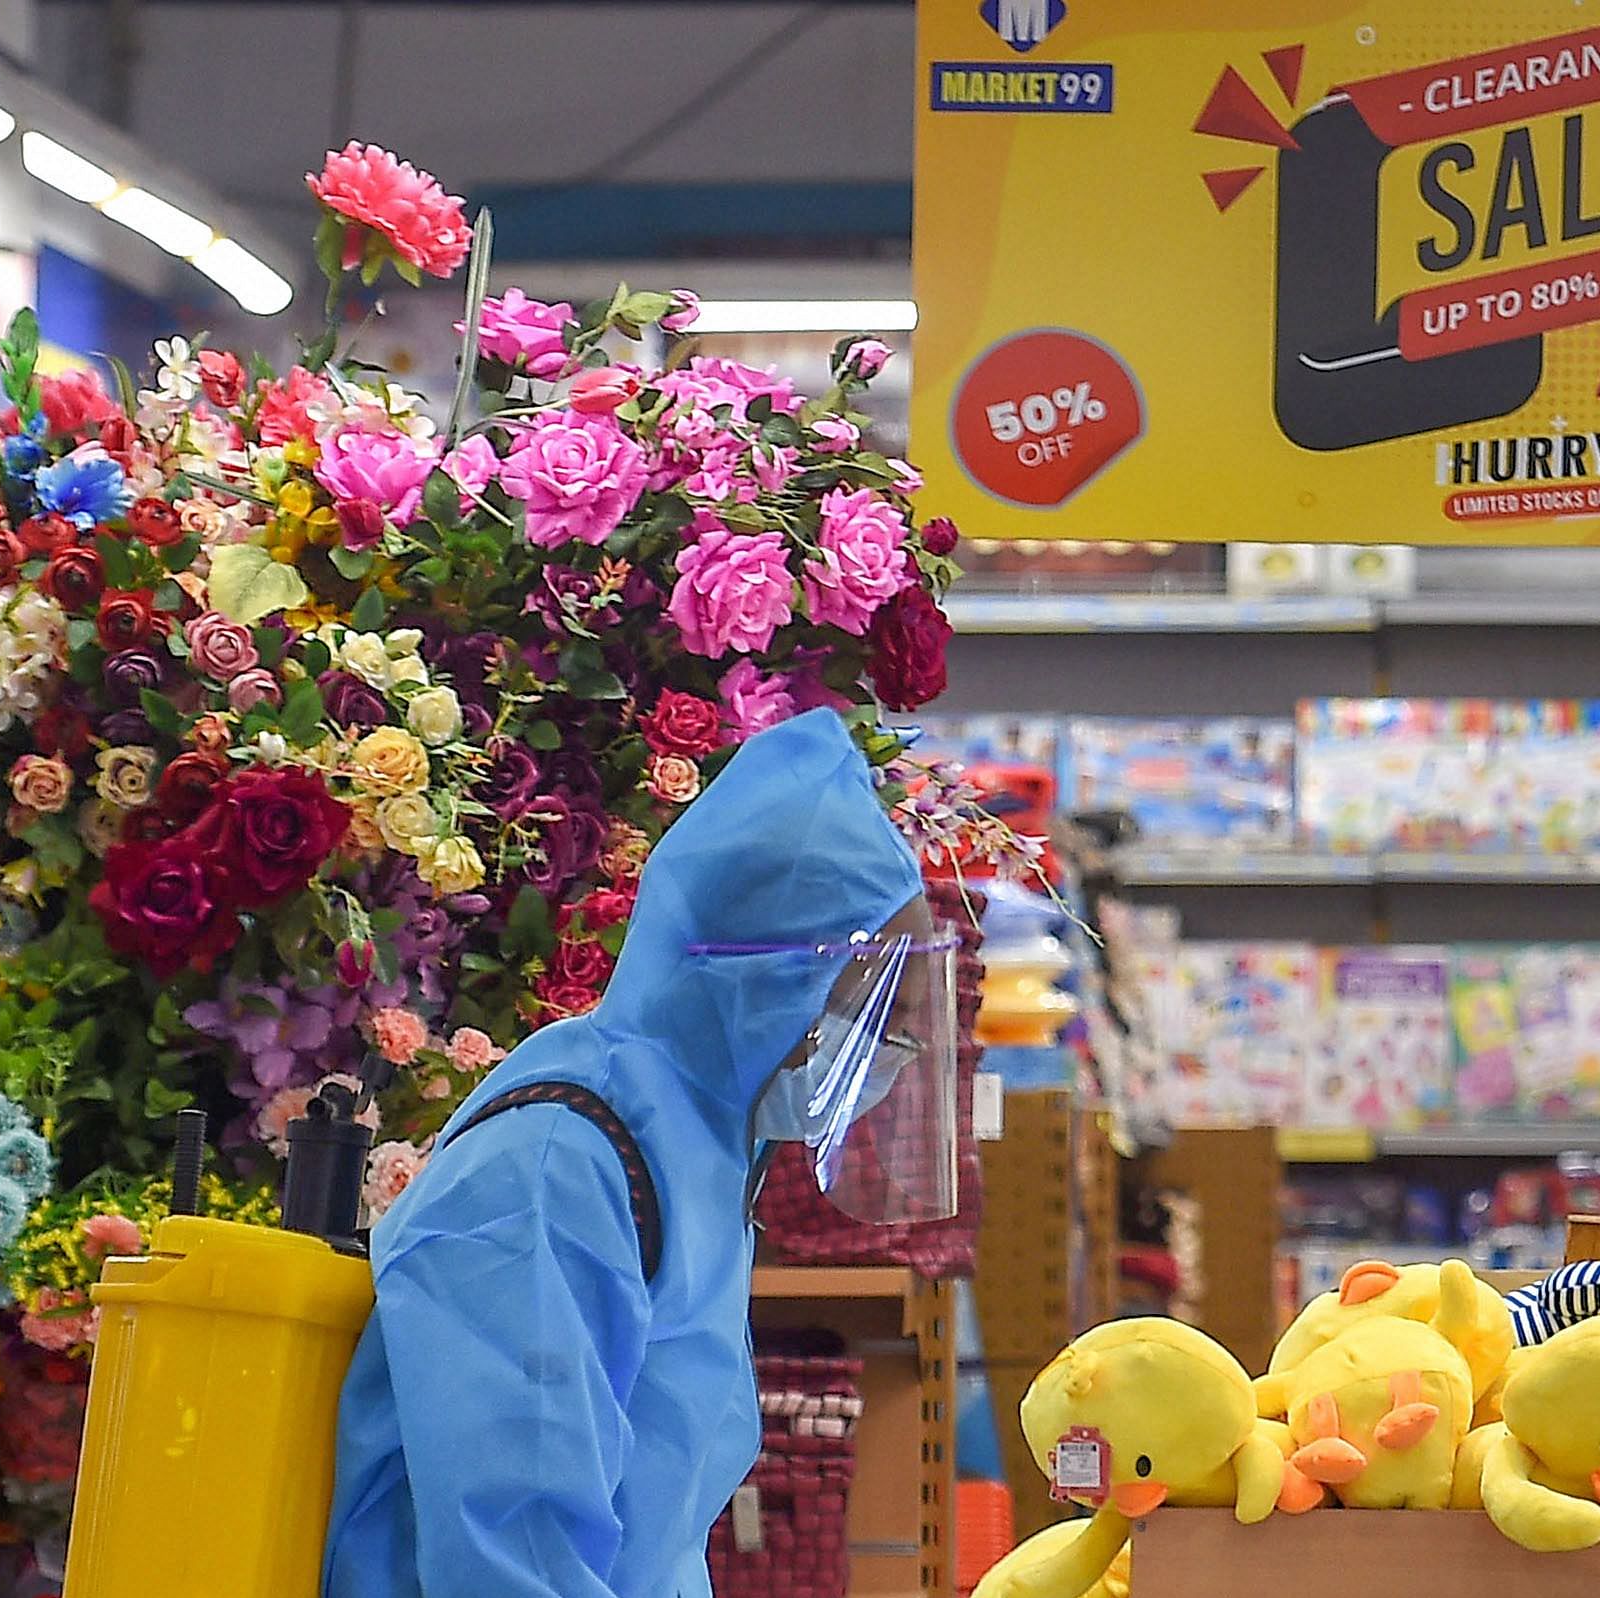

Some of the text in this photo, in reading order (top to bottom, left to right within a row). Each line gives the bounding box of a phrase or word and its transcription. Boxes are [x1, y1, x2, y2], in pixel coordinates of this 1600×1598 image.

[940, 71, 1103, 104] MARKET99
[1422, 301, 1469, 336] UP
[1476, 289, 1522, 323] TO
[1530, 271, 1600, 312] 80%
[986, 381, 1108, 442] 50%
[1016, 433, 1073, 468] OFF
[1453, 493, 1519, 516] LIMITED
[1521, 489, 1584, 512] STOCKS
